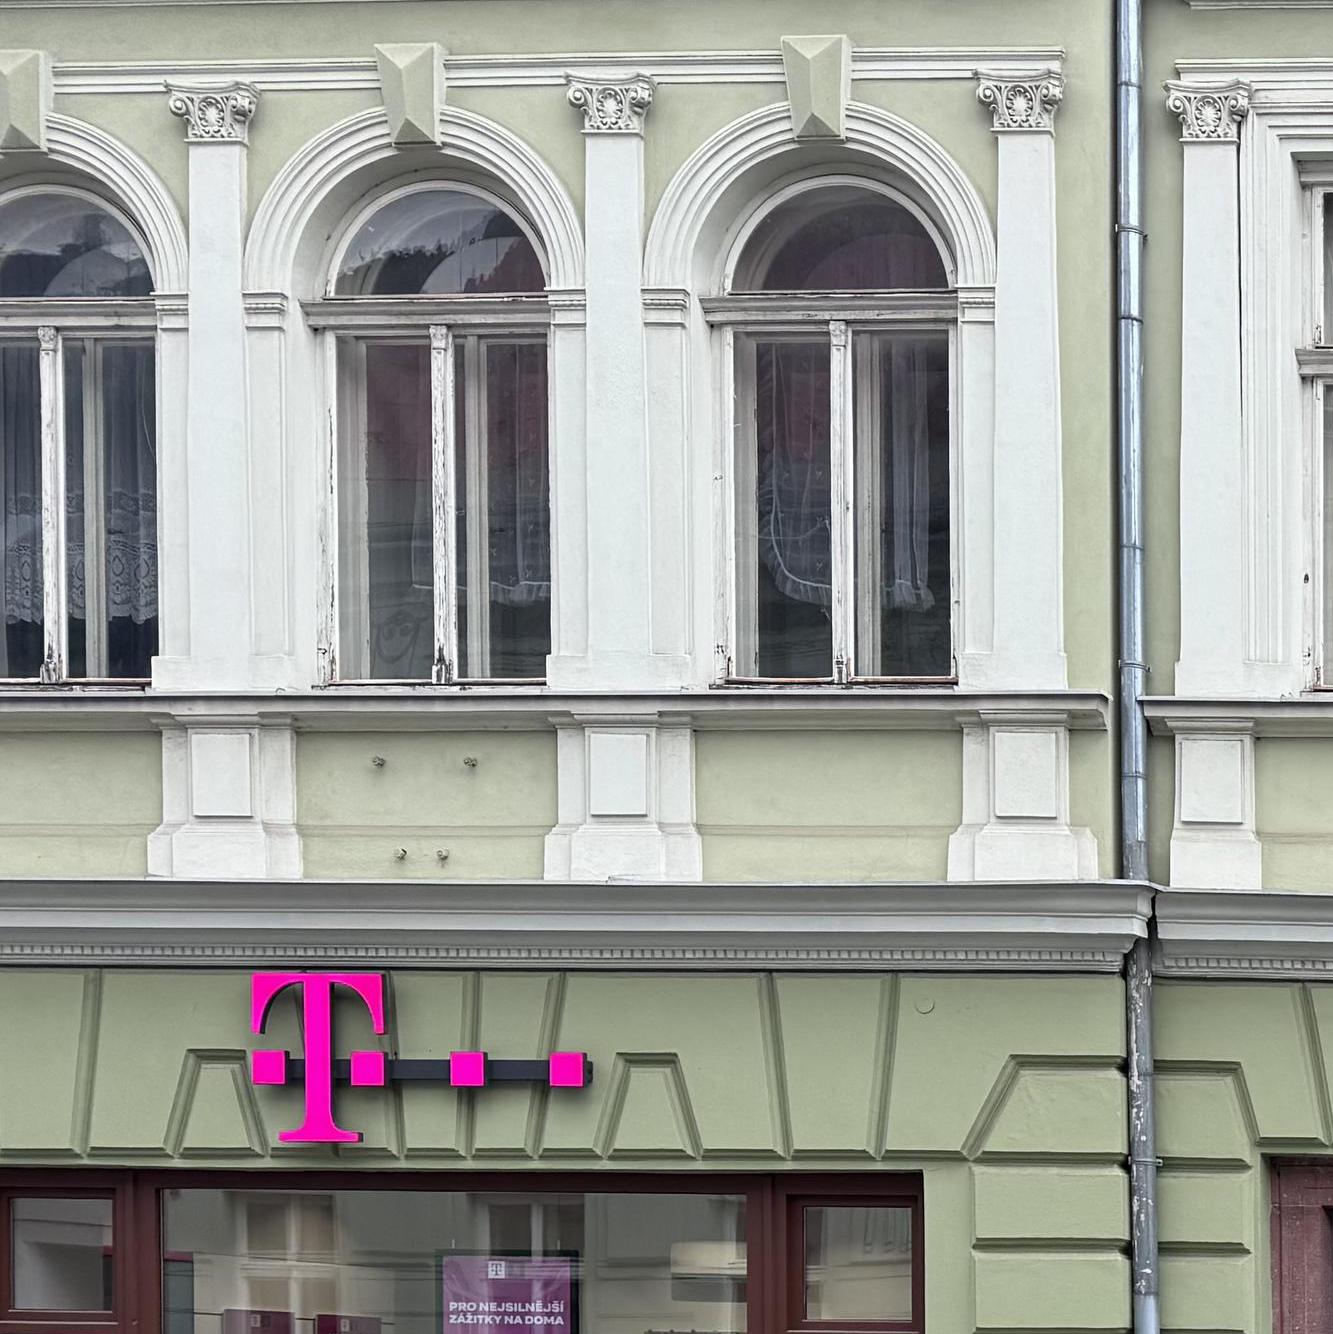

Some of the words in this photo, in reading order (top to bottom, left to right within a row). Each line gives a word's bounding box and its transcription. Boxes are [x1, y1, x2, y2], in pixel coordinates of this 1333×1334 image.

[448, 1301, 477, 1312] PRO
[479, 1300, 565, 1313] NEJSILNĚJŠÍ
[448, 1312, 502, 1325] ZÁŽITKY
[504, 1315, 523, 1325] NA
[525, 1315, 565, 1325] DOMA
